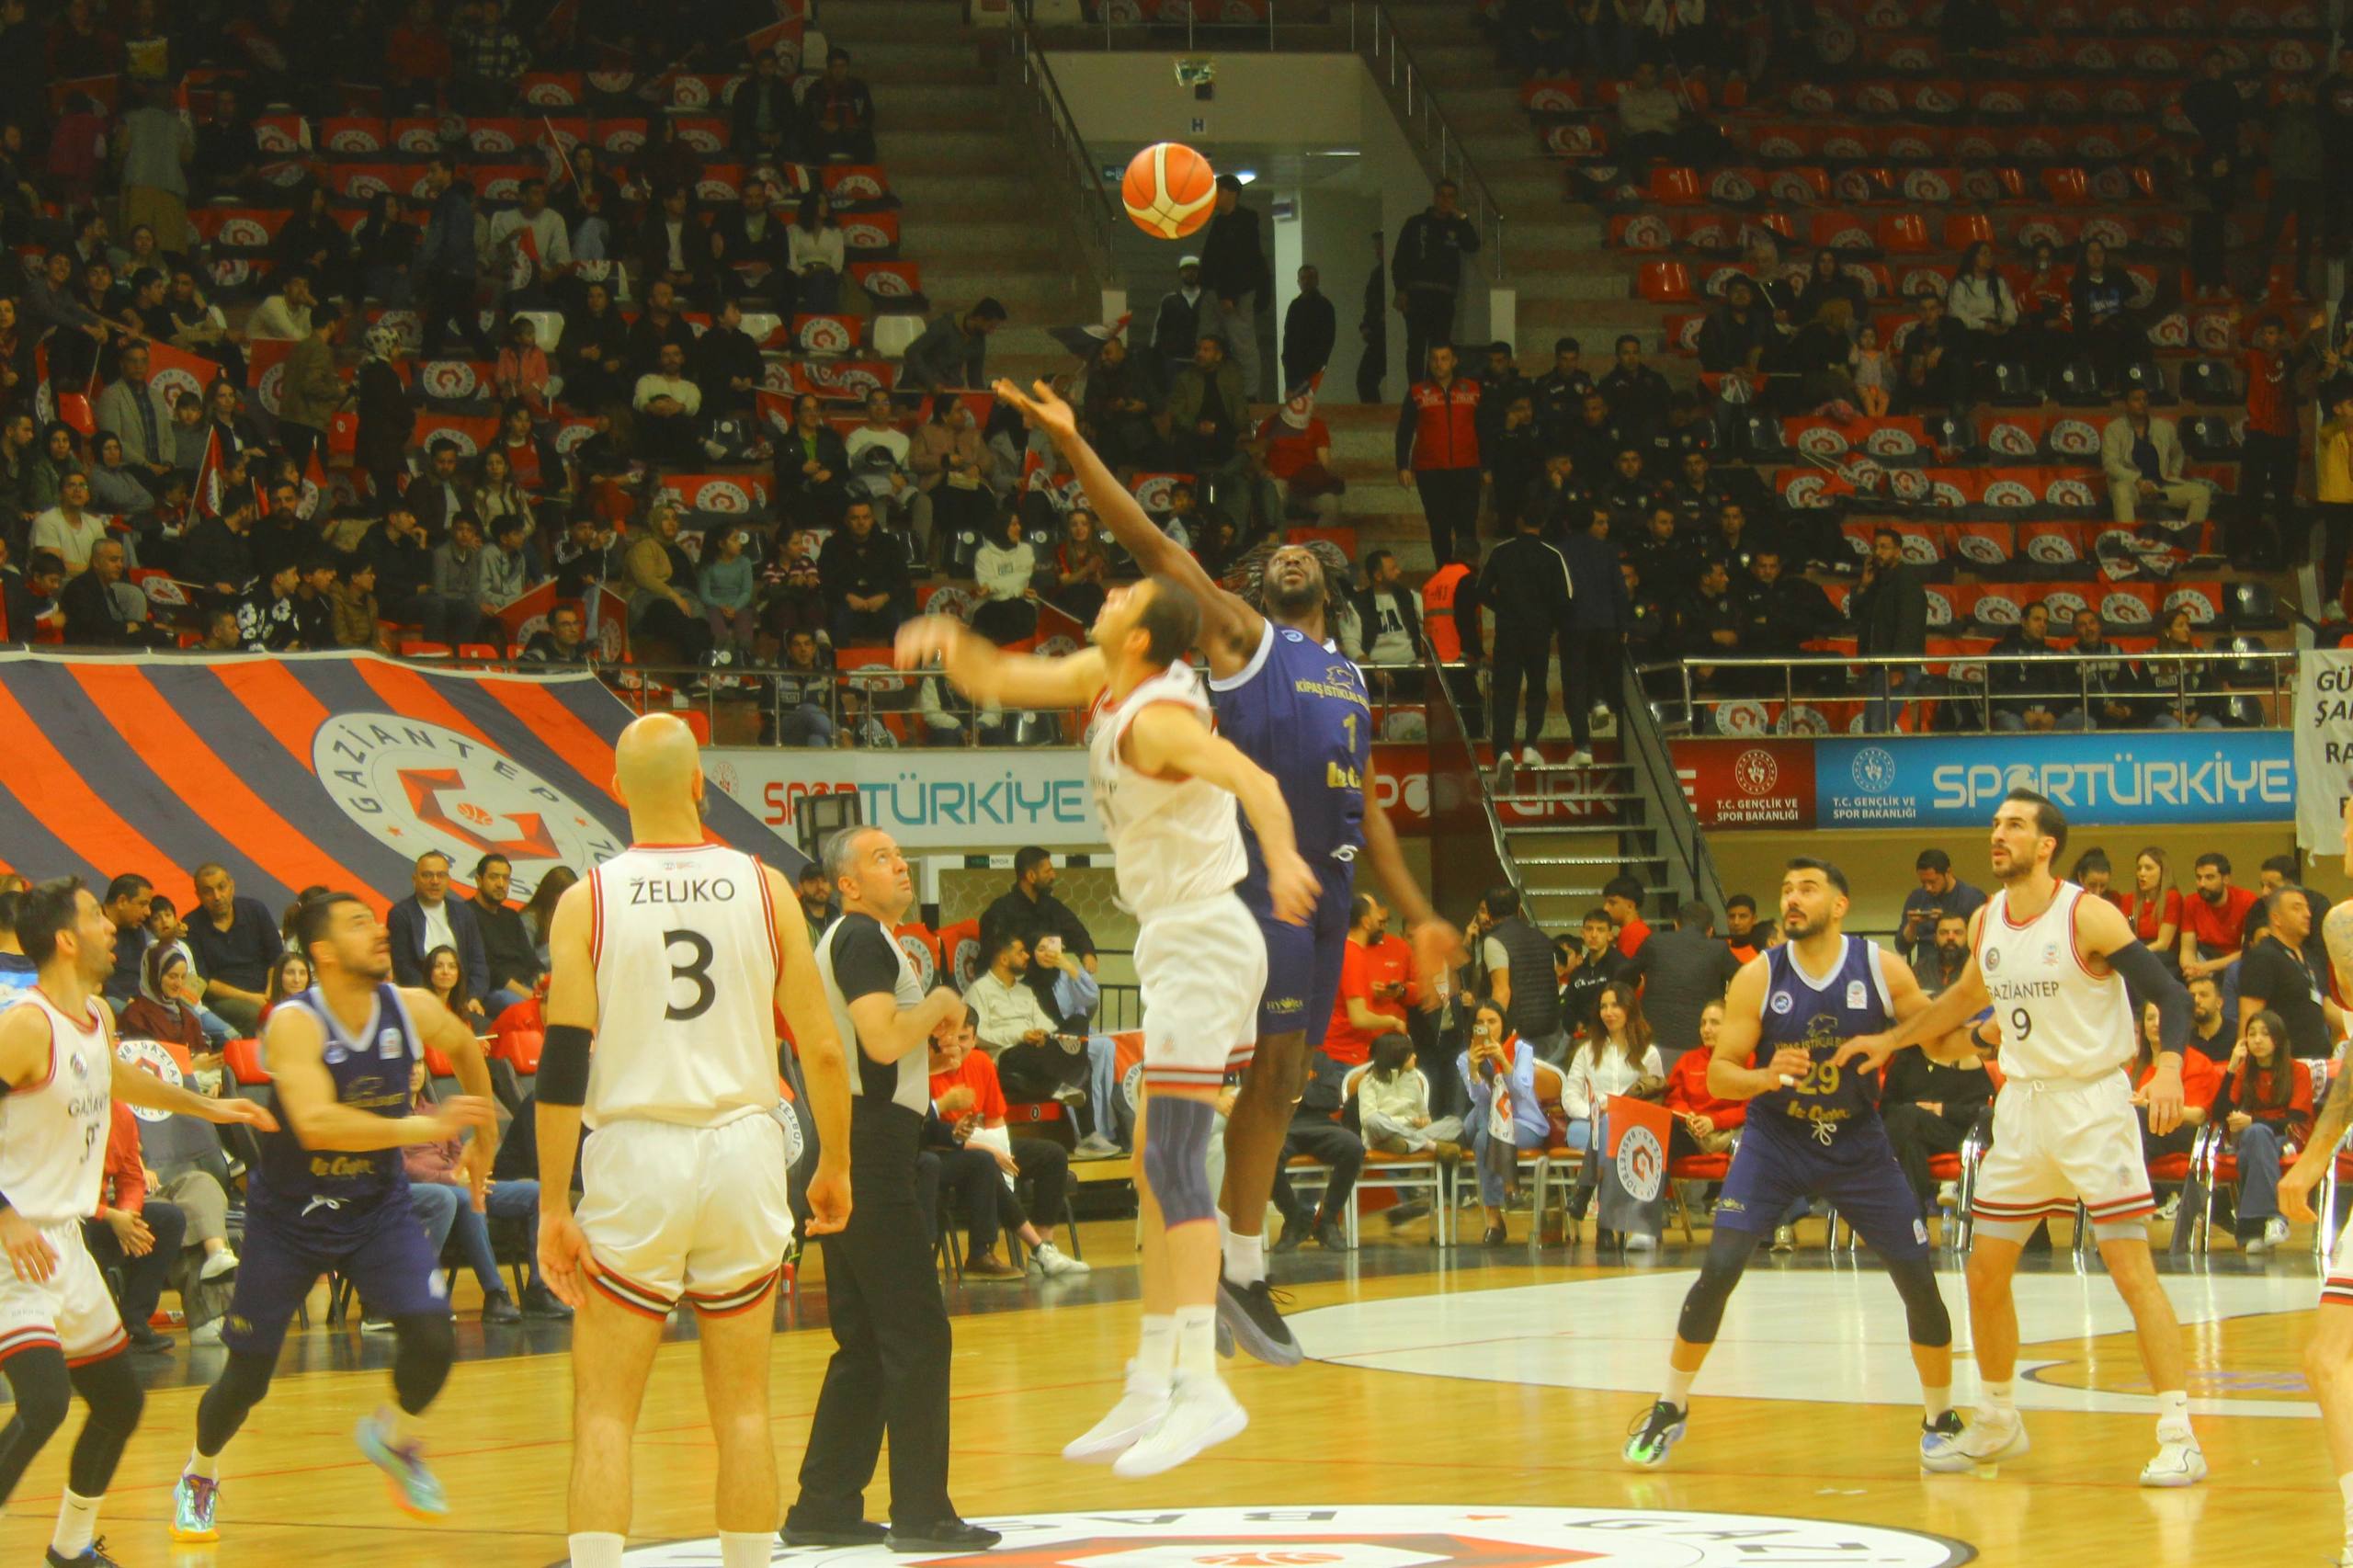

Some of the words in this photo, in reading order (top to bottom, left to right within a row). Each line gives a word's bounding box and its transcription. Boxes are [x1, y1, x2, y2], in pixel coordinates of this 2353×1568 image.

[2314, 700, 2353, 727] ŞA
[1343, 713, 1357, 753] 1
[333, 723, 560, 814] GAZİANTEP
[1717, 799, 1735, 809] T.C.
[1737, 797, 1782, 811] GENÇLİK
[1785, 798, 1798, 808] VE
[1717, 811, 1744, 822] SPOR
[1745, 809, 1799, 821] BAKANLIĞI
[1833, 797, 1851, 808] T.C.
[1853, 795, 1898, 809] GENÇLİK
[1902, 797, 1915, 807] VE
[1833, 809, 1860, 820] SPOR
[1862, 807, 1915, 819] BAKANLIĞI
[630, 877, 735, 905] ŽELJKO
[662, 929, 716, 1021] 3
[2011, 1007, 2032, 1041] 9
[1796, 1060, 1840, 1096] 29
